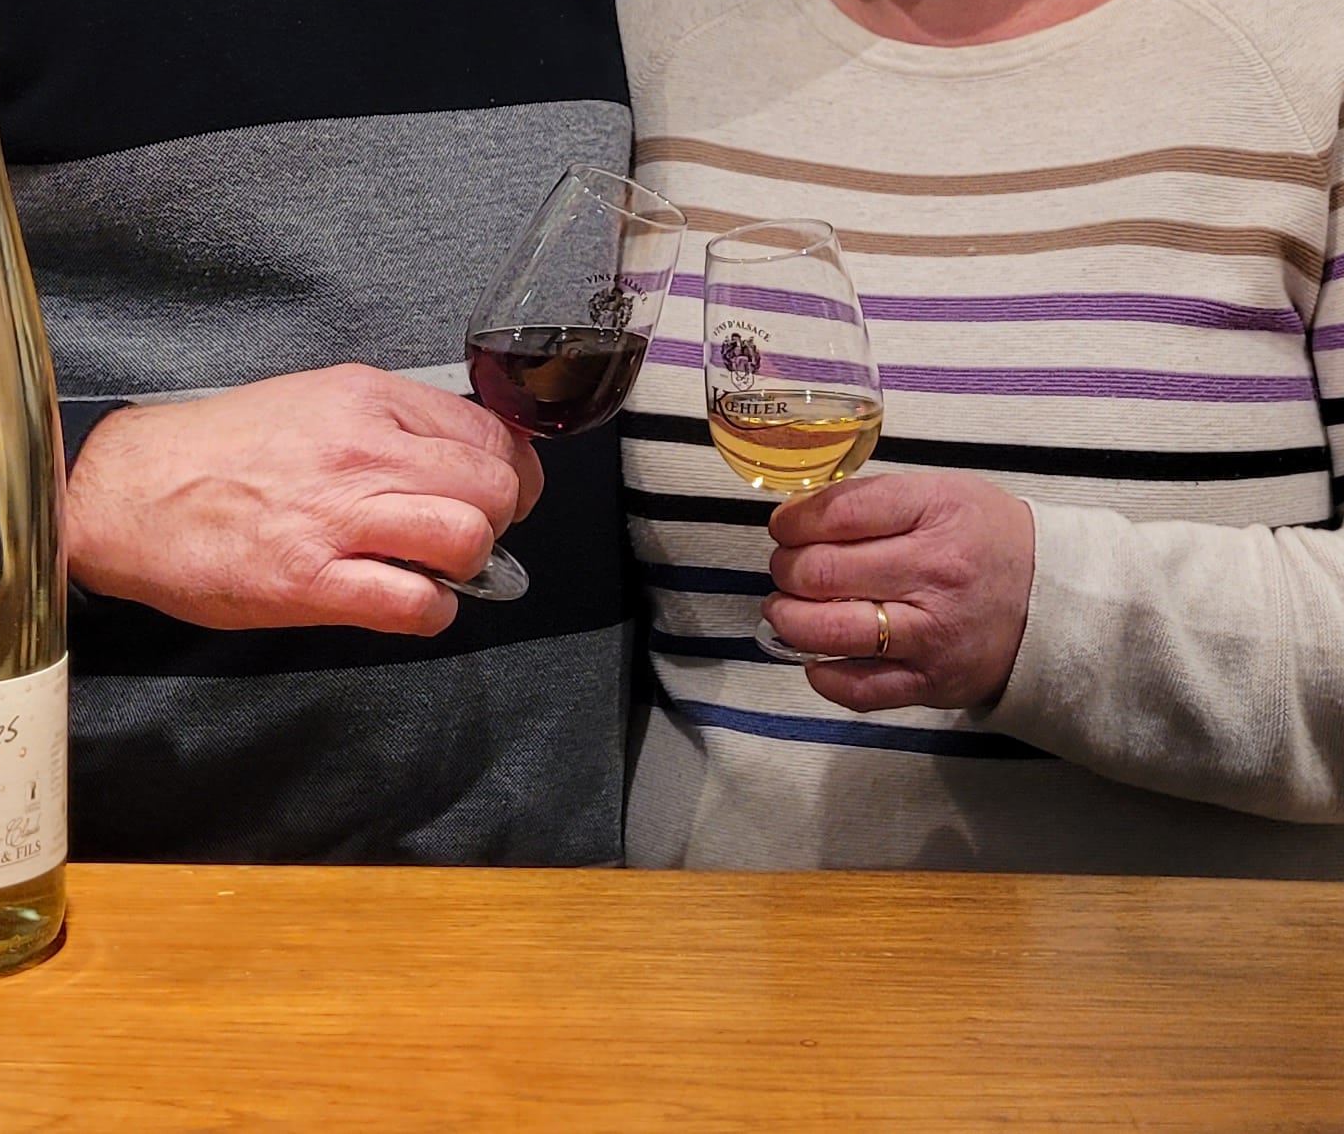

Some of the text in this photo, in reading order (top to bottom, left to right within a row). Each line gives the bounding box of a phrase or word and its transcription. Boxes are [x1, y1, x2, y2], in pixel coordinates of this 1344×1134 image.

[586, 274, 611, 284] VINS
[728, 320, 771, 342] D'ALSACE
[1, 851, 11, 863] &
[16, 840, 42, 860] FILS
